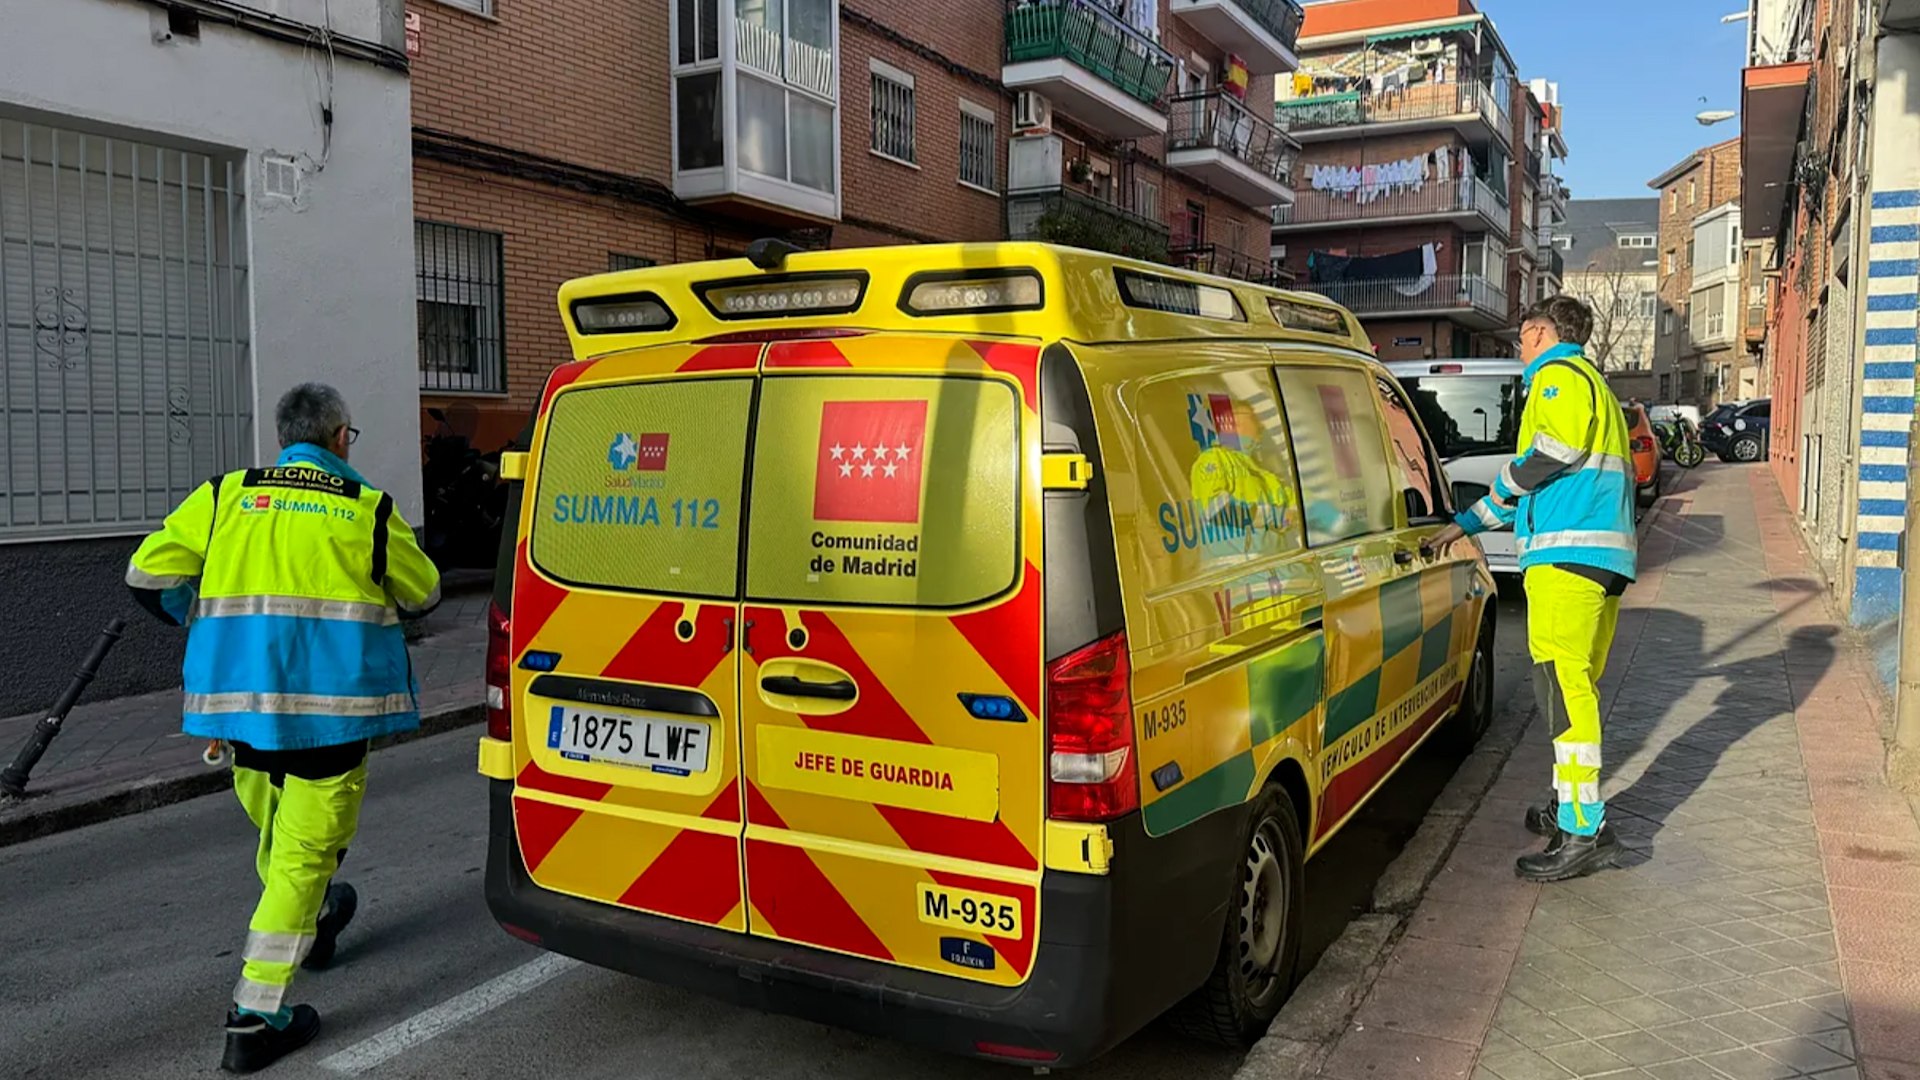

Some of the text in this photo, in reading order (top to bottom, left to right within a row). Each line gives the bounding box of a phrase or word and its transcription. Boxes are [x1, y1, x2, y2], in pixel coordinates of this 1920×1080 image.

[273, 500, 328, 515] SUMMA
[333, 507, 355, 521] 112
[553, 494, 720, 528] SUMMA 112
[811, 531, 918, 552] Comunidad
[810, 554, 916, 577] de Madrid
[1144, 699, 1186, 741] M-935
[1375, 715, 1387, 741] DE
[572, 714, 700, 763] 1875 LWF
[794, 752, 954, 791] JEFE DE GUARDIA
[925, 890, 1015, 931] M-935
[951, 953, 985, 968] FRAIKIN
[963, 941, 971, 954] F
